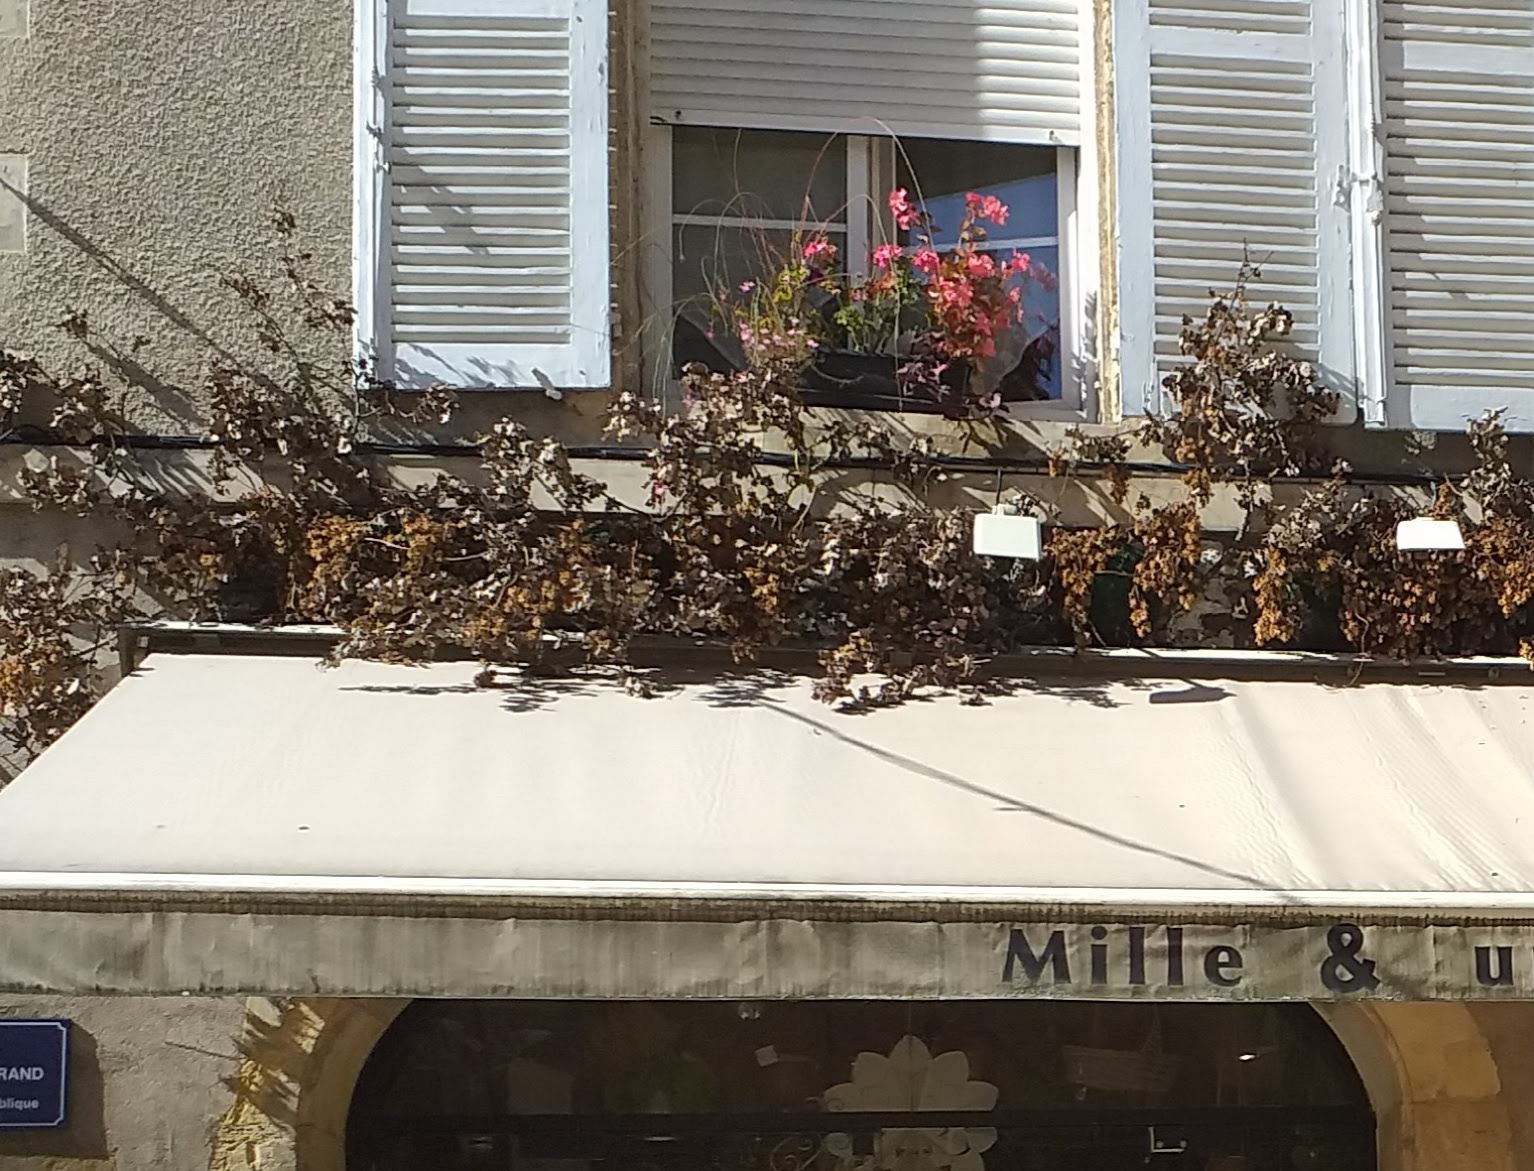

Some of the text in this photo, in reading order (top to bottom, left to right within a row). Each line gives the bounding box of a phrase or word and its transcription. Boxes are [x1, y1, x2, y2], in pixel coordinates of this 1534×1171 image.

[1001, 925, 1243, 987] Mille
[1320, 922, 1380, 994] &
[0, 1067, 44, 1080] RAND
